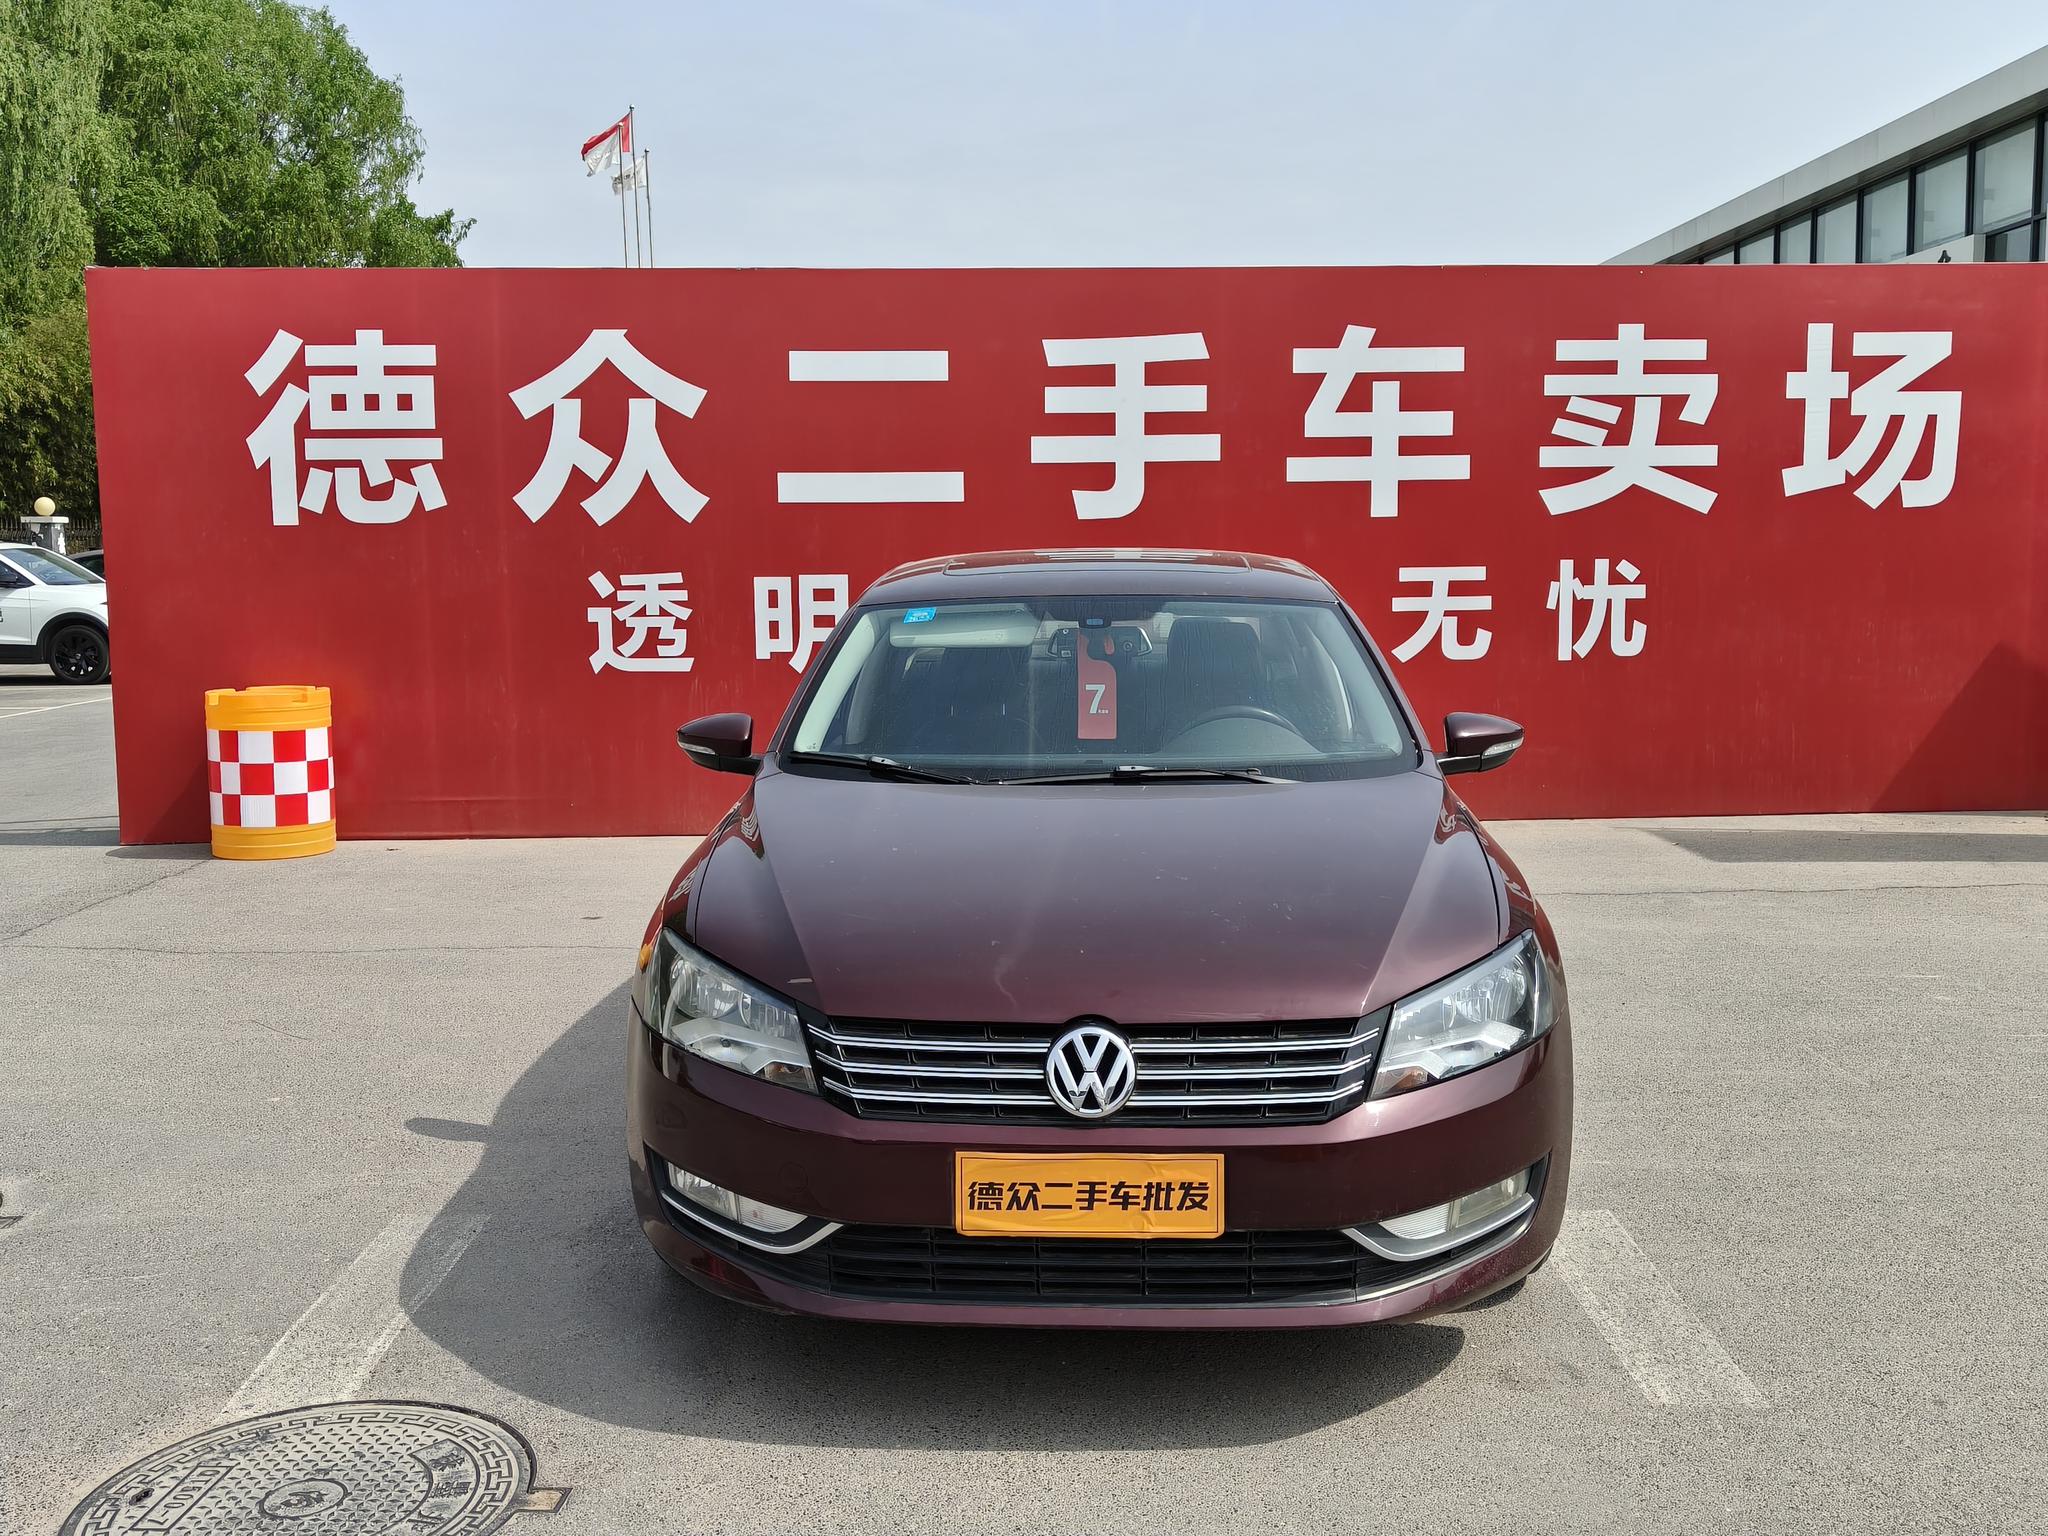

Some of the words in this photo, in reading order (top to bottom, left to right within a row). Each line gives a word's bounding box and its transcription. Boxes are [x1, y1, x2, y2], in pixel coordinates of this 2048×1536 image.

[244, 322, 1963, 526] 德众二手车卖场
[587, 570, 850, 675] 透明
[1391, 558, 1648, 663] 无忧
[1086, 684, 1106, 714] 7
[967, 1181, 1210, 1212] 德众二手车批发
